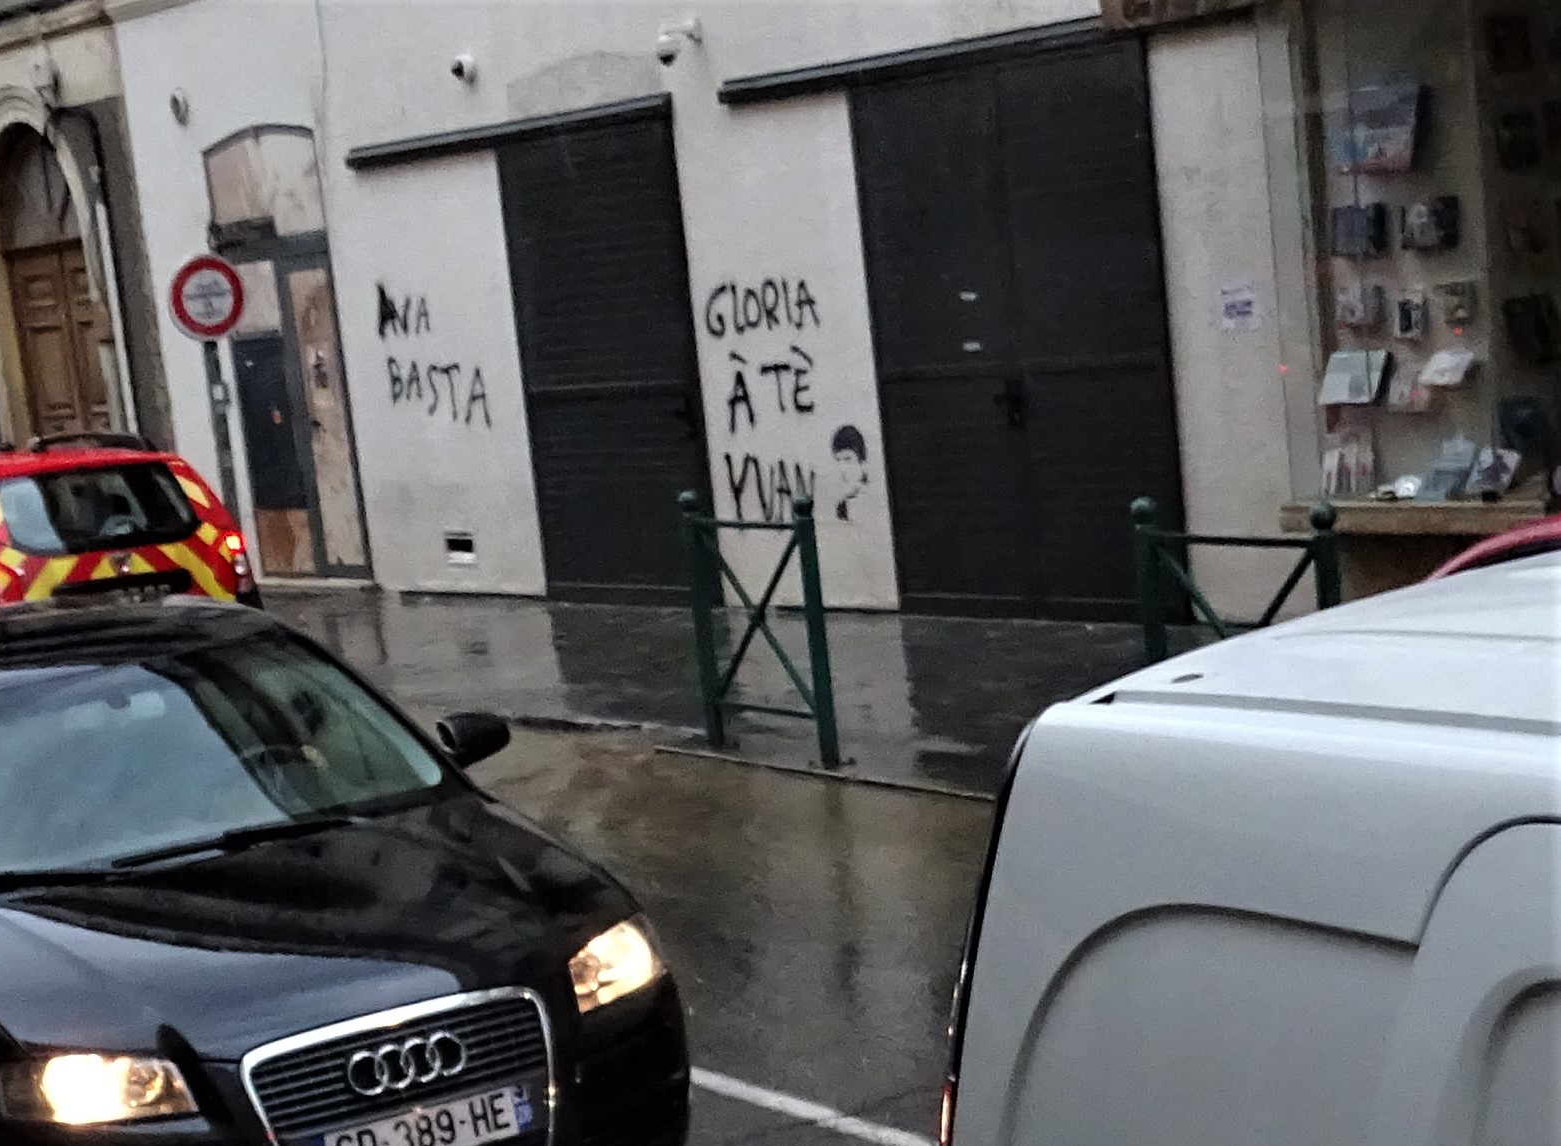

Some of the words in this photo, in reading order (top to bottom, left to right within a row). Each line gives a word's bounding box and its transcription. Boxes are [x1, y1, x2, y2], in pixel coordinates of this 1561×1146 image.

[377, 281, 431, 340] AVA
[706, 277, 821, 338] GLORIA
[388, 356, 492, 428] BASTA
[727, 351, 755, 433] À
[760, 345, 815, 413] TÈ
